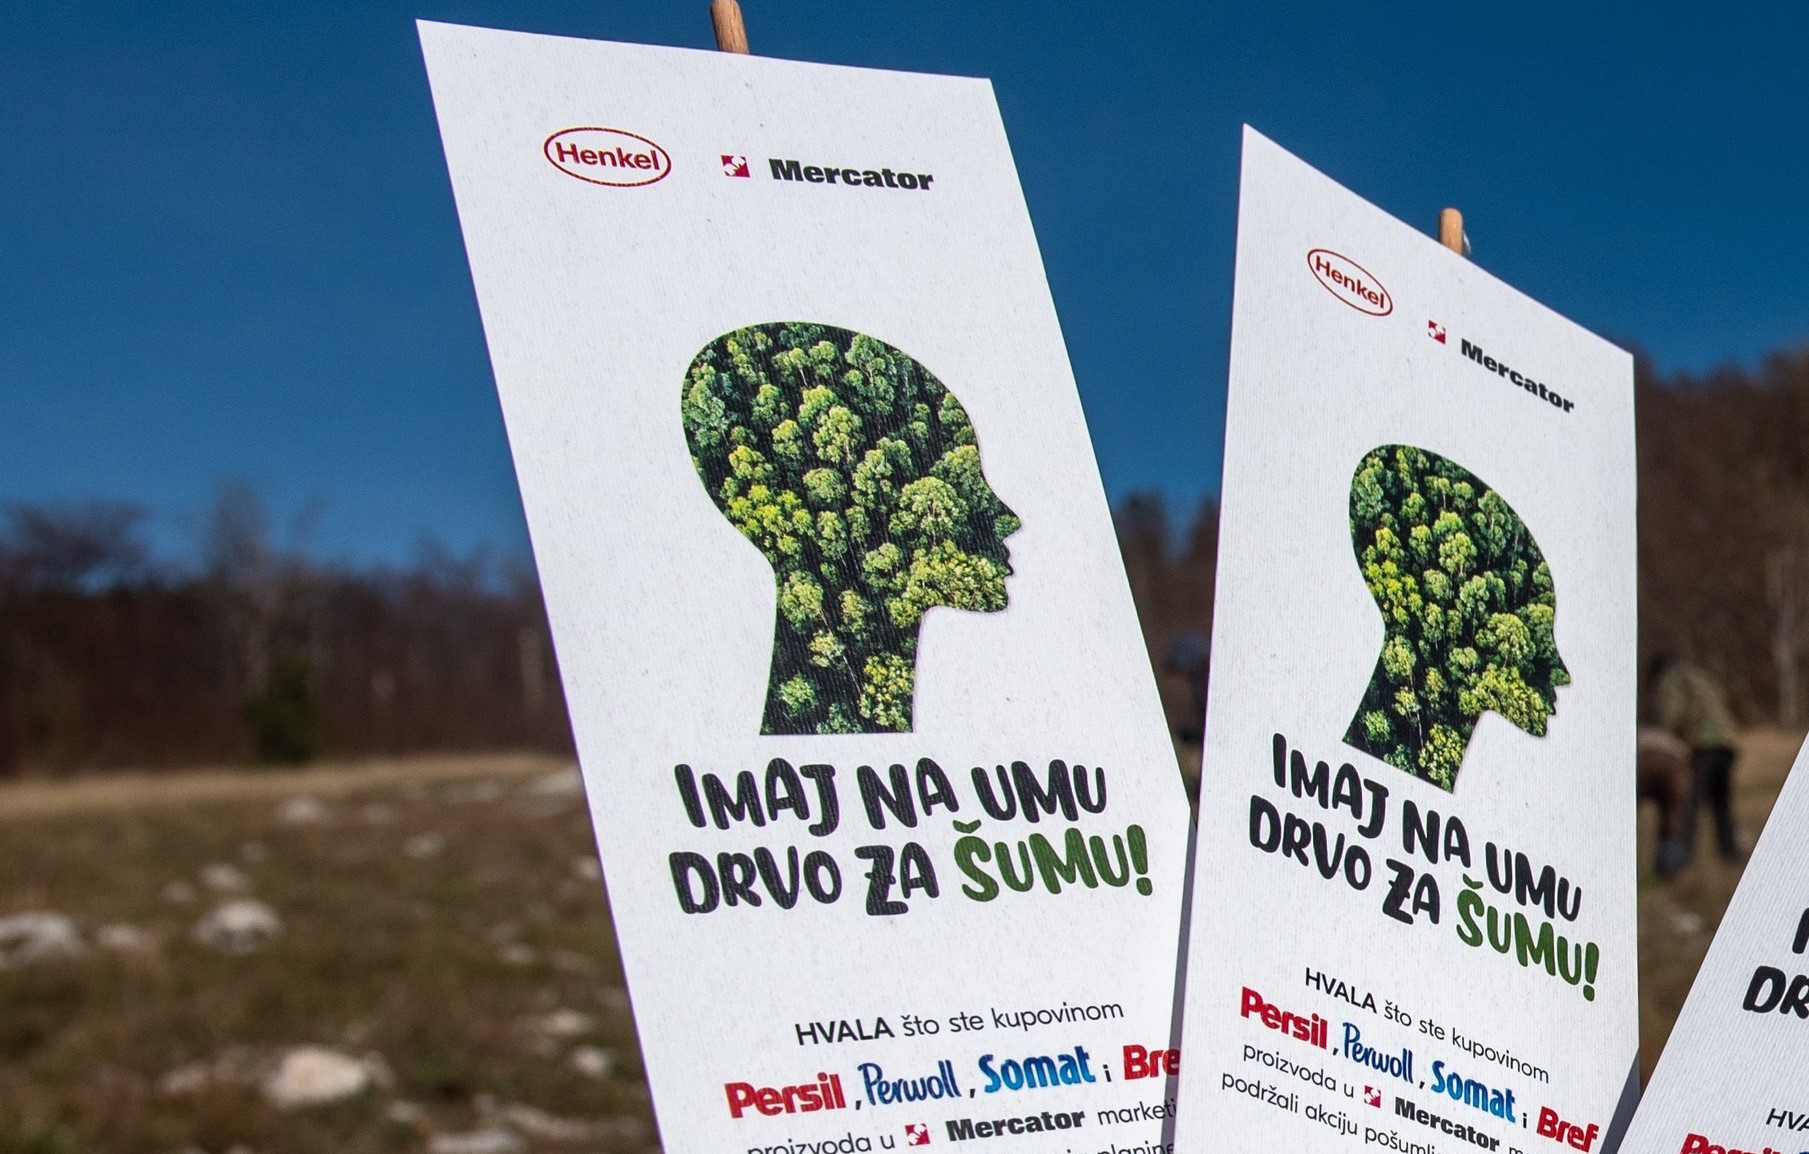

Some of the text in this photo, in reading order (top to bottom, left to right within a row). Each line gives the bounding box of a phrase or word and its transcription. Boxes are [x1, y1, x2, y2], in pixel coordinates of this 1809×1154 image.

[555, 142, 661, 171] Henkel
[768, 157, 934, 190] Mercator
[1315, 255, 1385, 309] Henkel
[1461, 338, 1575, 413] Mercator
[674, 757, 1107, 837] IMAJ NA UMU
[1272, 732, 1582, 921] IMAJ NA UMU
[668, 819, 1153, 916] DRVO ZA ŠUMU!
[1249, 794, 1600, 1002] DRVO ZA ŠUMU!
[794, 1001, 1124, 1046] HVALA što ste kupovinom
[1305, 967, 1550, 1084] HVALA što ste kupovinom
[978, 1045, 1097, 1094] Somat
[1103, 1064, 1112, 1083] i
[1221, 1070, 1299, 1116] podržali
[1305, 1100, 1358, 1136] akciju
[1242, 1042, 1337, 1092] proizvoda
[1343, 1081, 1355, 1099] u
[1394, 1096, 1500, 1153] Mercator
[1430, 1059, 1517, 1124] Somat
[1522, 1112, 1527, 1129] i
[1536, 1105, 1599, 1154] Bref
[879, 1131, 895, 1151] u
[945, 1109, 1085, 1142] Mercator
